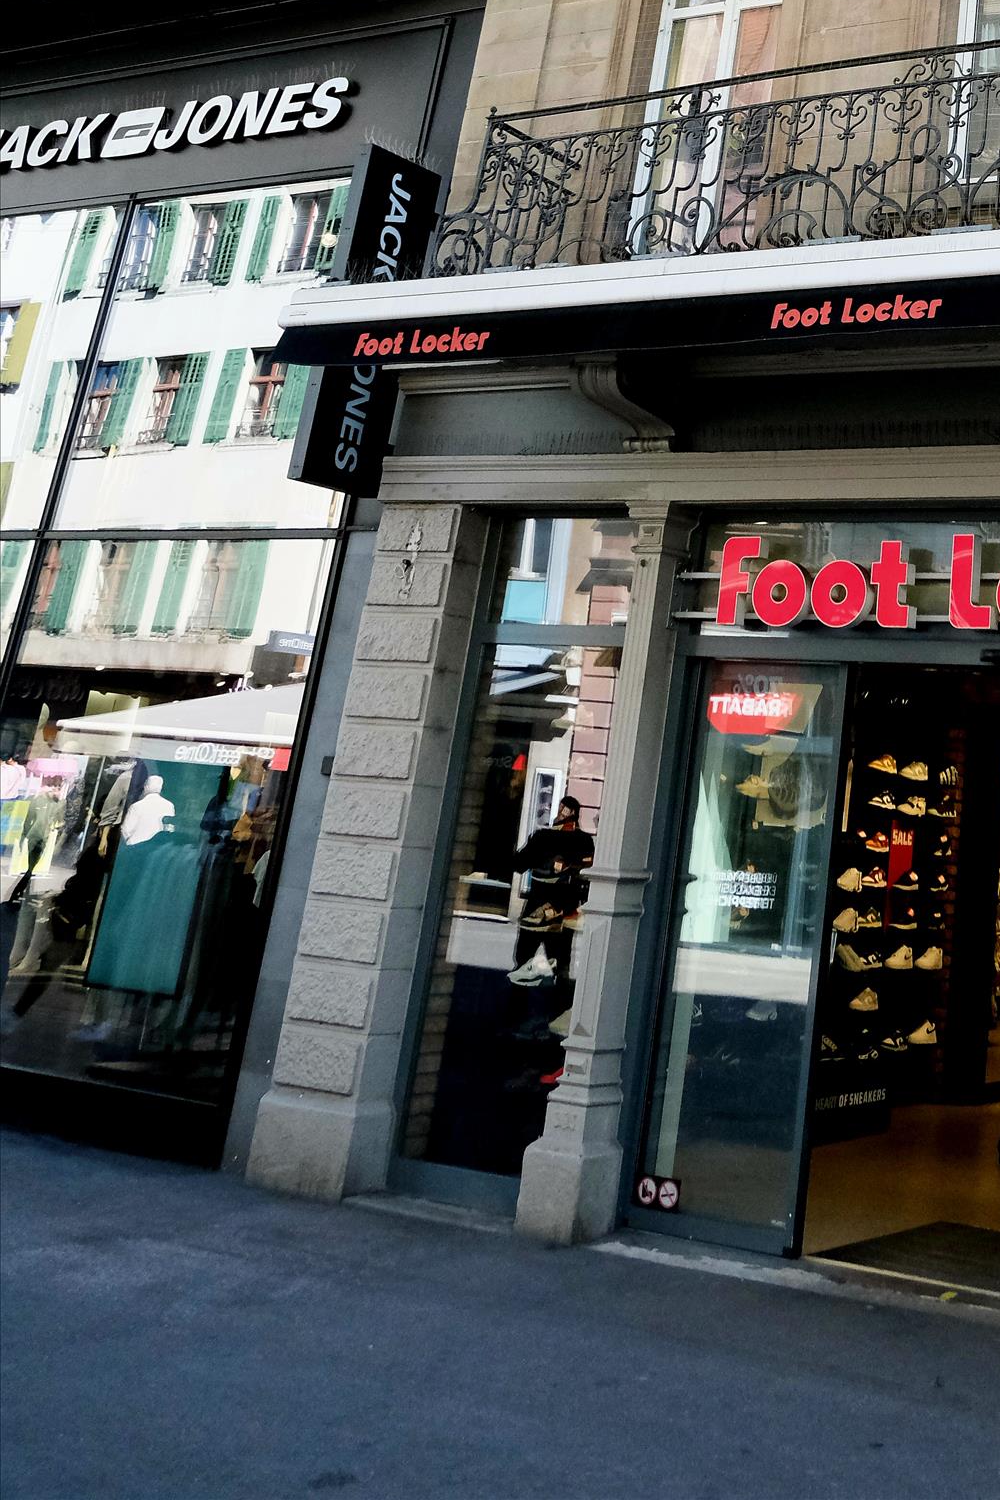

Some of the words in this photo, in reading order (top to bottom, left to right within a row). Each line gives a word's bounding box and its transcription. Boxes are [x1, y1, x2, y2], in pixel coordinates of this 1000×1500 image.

[0, 113, 110, 169] ACK
[153, 77, 349, 150] JONES
[371, 173, 411, 282] JACK
[353, 331, 404, 357] Foot
[410, 326, 490, 354] Locker
[770, 301, 833, 330] Foot
[840, 294, 943, 324] Locker
[334, 364, 376, 473] ONES
[715, 535, 911, 628] Foot
[891, 829, 914, 846] SALE
[838, 1094, 848, 1108] OF
[848, 1088, 886, 1106] SNEAKERS
